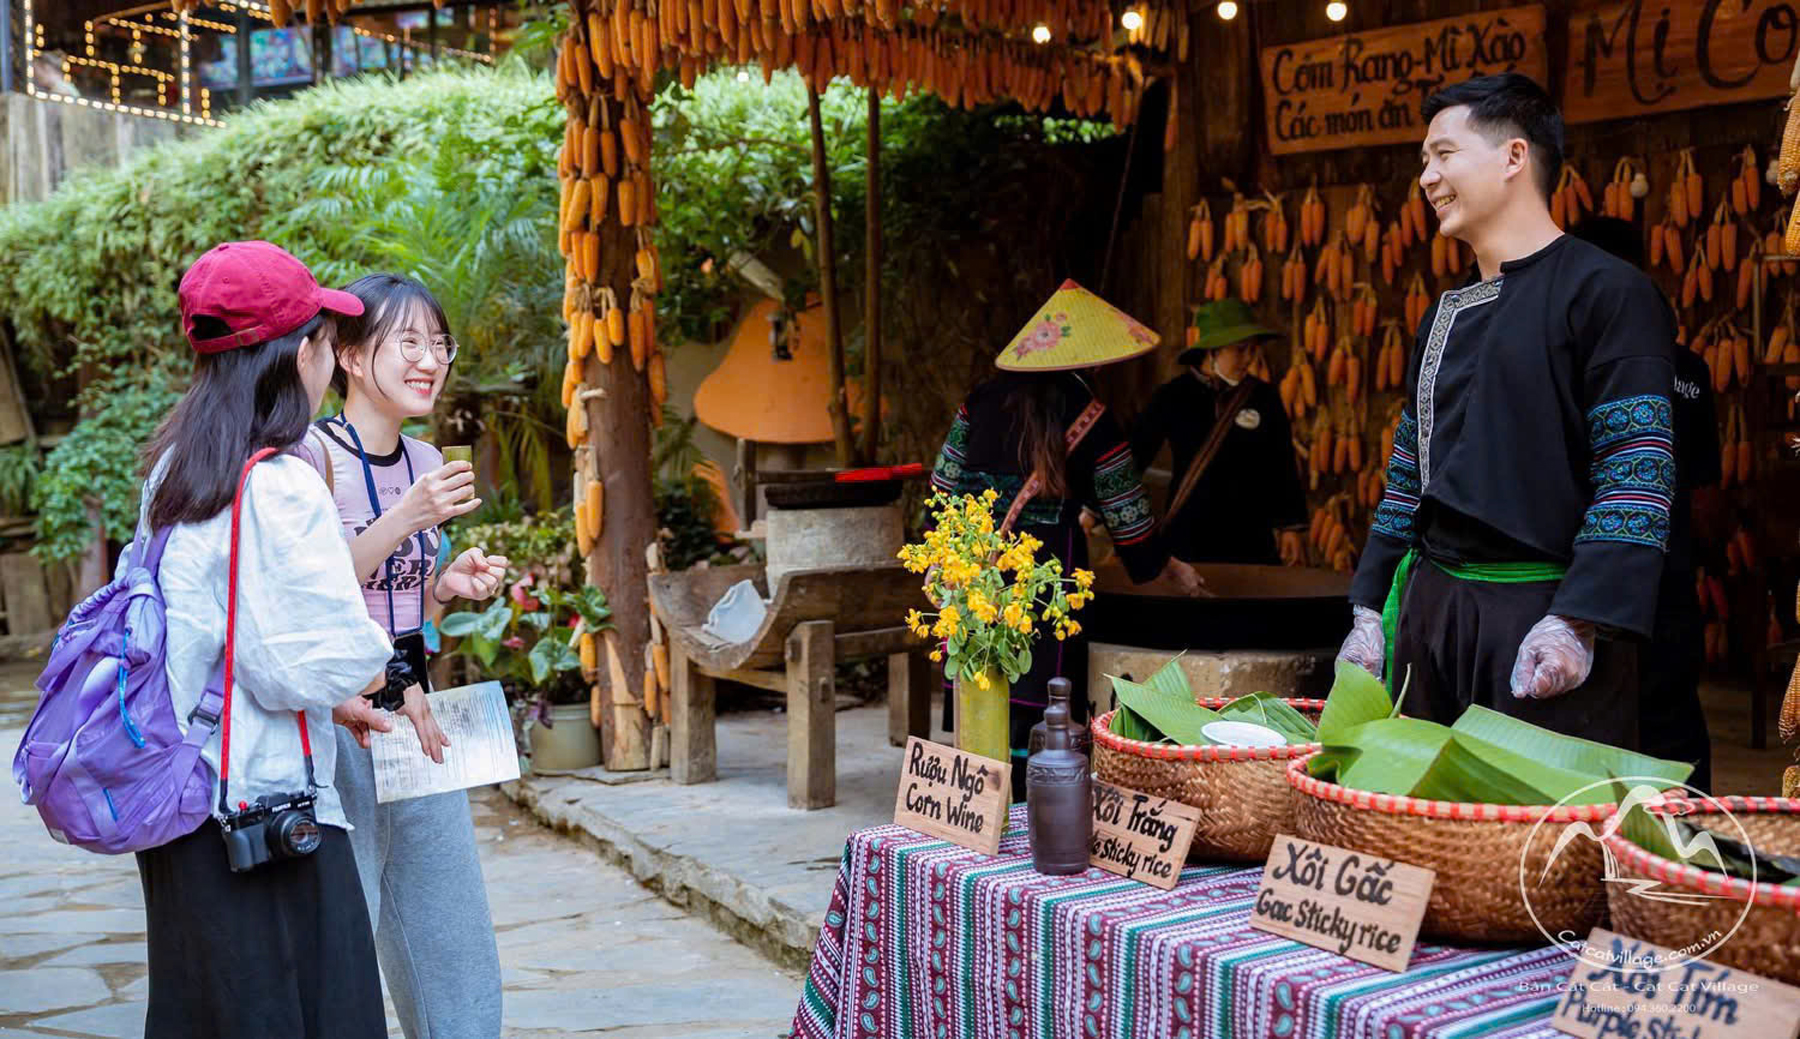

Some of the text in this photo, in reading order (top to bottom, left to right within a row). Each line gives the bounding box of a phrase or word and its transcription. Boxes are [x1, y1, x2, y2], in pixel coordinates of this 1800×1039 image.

[1466, 17, 1527, 69] Xào
[1275, 100, 1320, 141] Các
[1324, 92, 1374, 135] món
[909, 741, 989, 802] Rượu Ngô
[906, 782, 984, 833] Corn Wine
[1127, 794, 1178, 853] Trắng
[1141, 854, 1172, 878] rice
[1272, 842, 1395, 905] Xôi Gấc
[1256, 888, 1293, 922] Gac
[1360, 923, 1402, 954] rice
